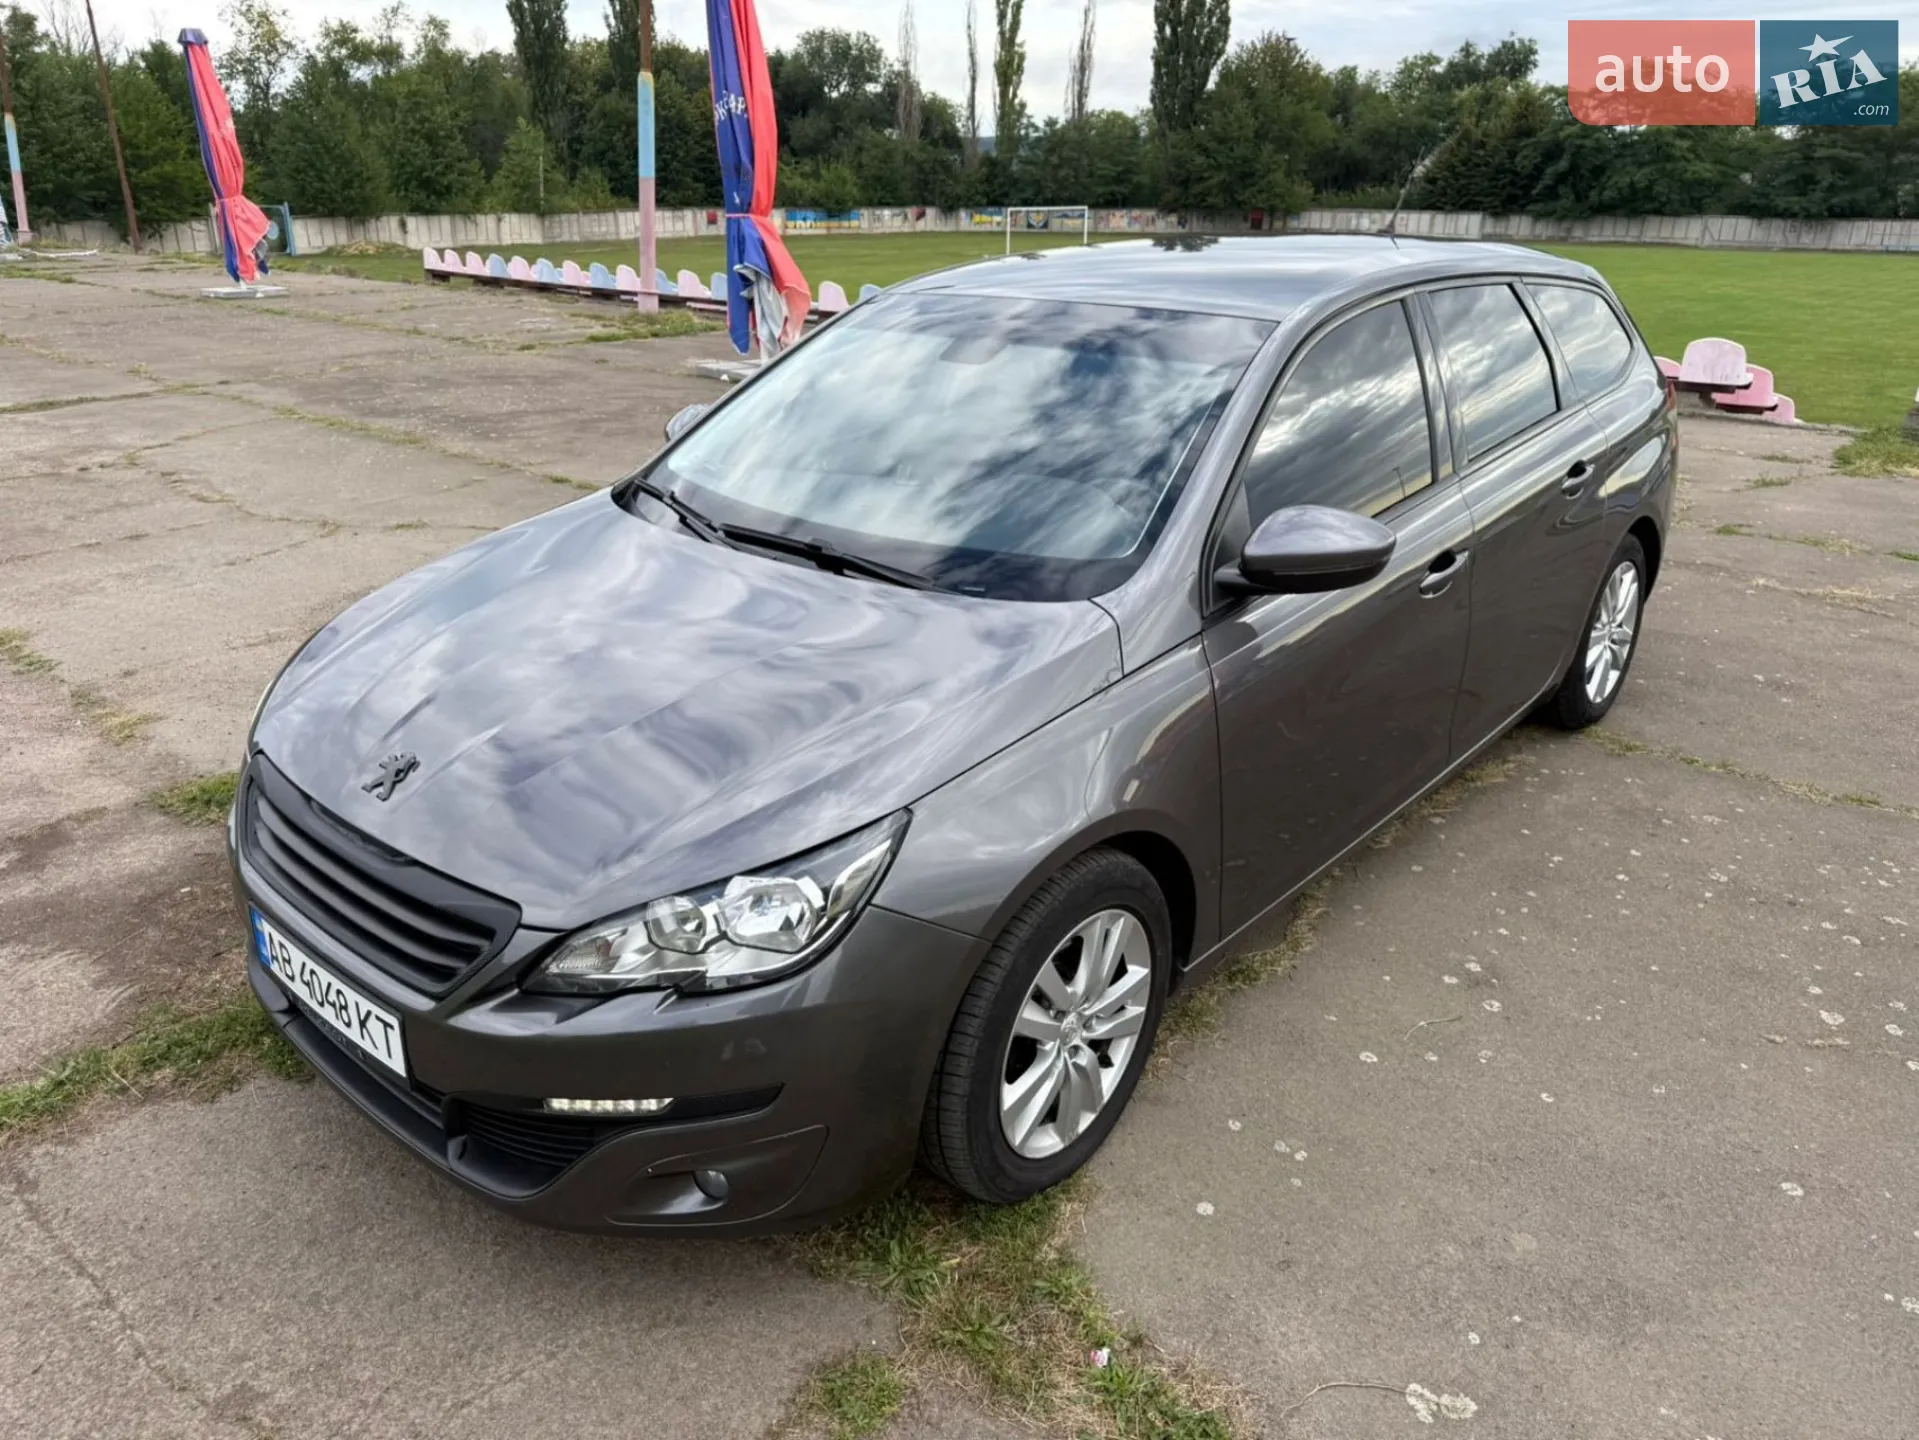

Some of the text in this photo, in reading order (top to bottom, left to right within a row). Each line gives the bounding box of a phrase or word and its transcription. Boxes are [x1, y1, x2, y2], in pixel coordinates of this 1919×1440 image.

[268, 931, 295, 983] AB
[300, 961, 352, 1029] 4048
[355, 1000, 395, 1060] KT
